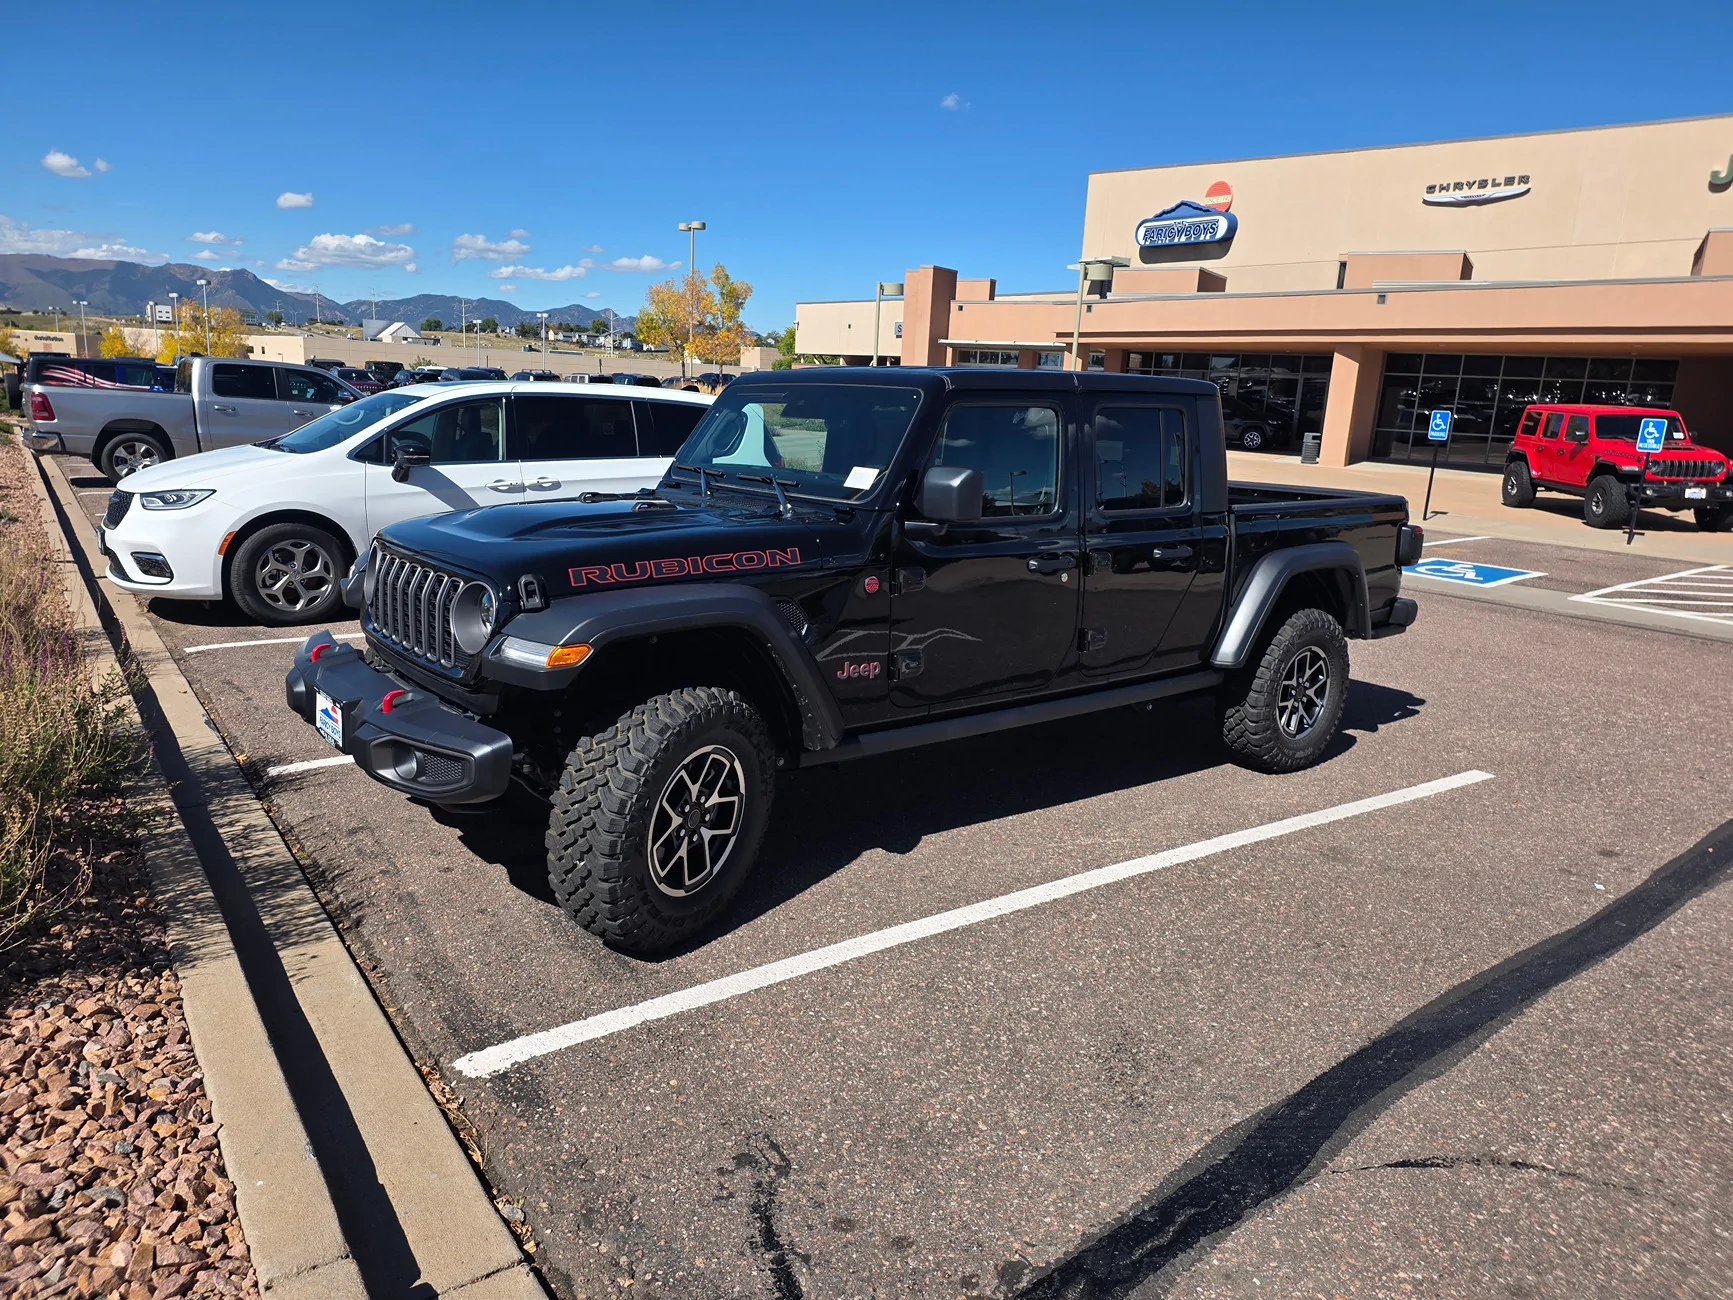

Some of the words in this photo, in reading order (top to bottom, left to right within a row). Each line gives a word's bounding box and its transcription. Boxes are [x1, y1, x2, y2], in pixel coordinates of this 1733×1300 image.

[1425, 175, 1531, 194] CHRYSLER
[568, 548, 801, 587] RUBICON
[837, 661, 881, 680] Jeep
